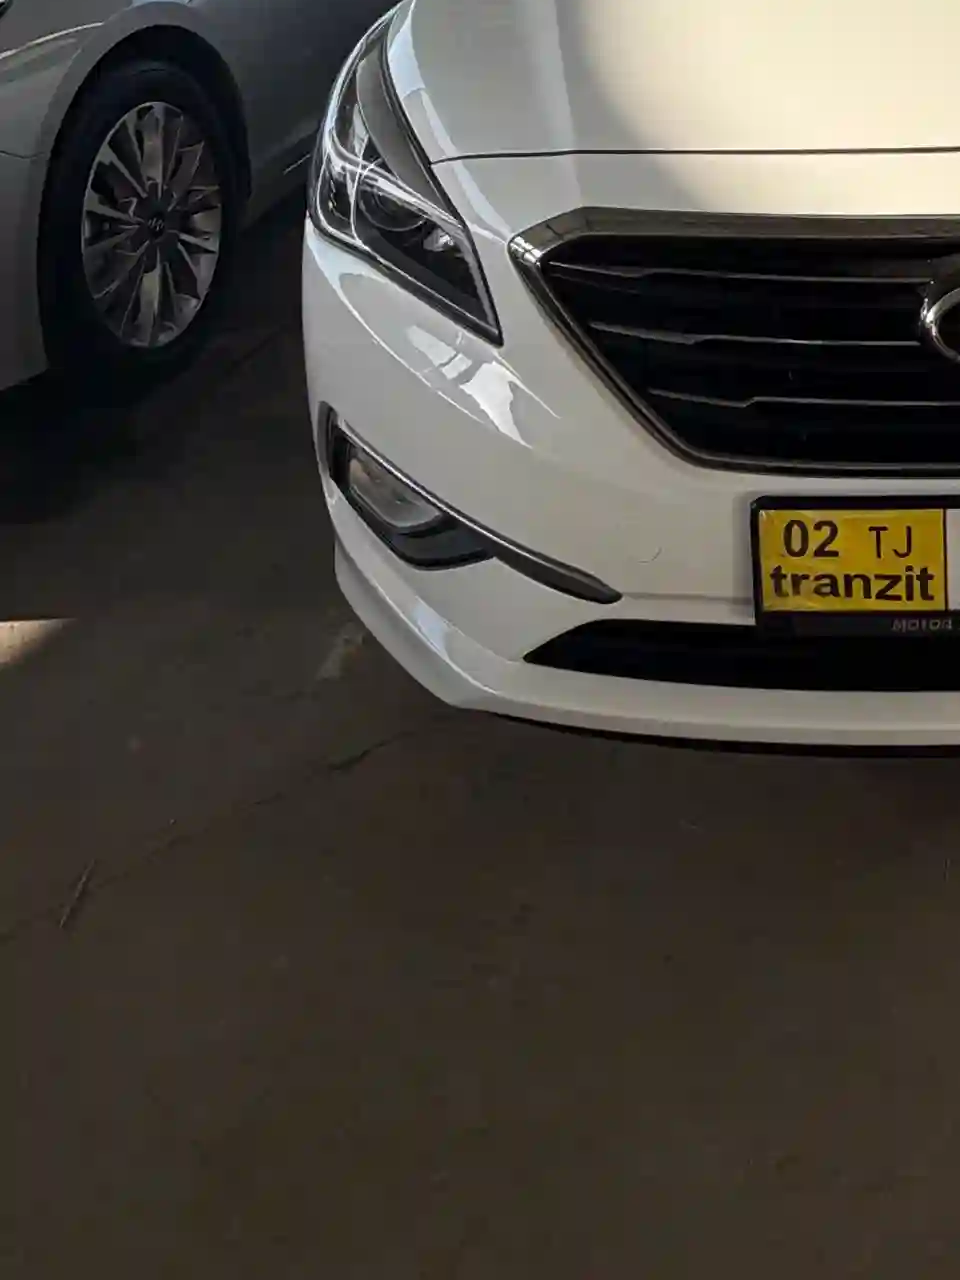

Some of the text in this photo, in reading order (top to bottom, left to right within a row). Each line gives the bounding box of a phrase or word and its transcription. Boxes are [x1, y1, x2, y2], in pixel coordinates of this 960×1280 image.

[783, 519, 914, 559] 02 TJ
[770, 564, 936, 603] tranzit
